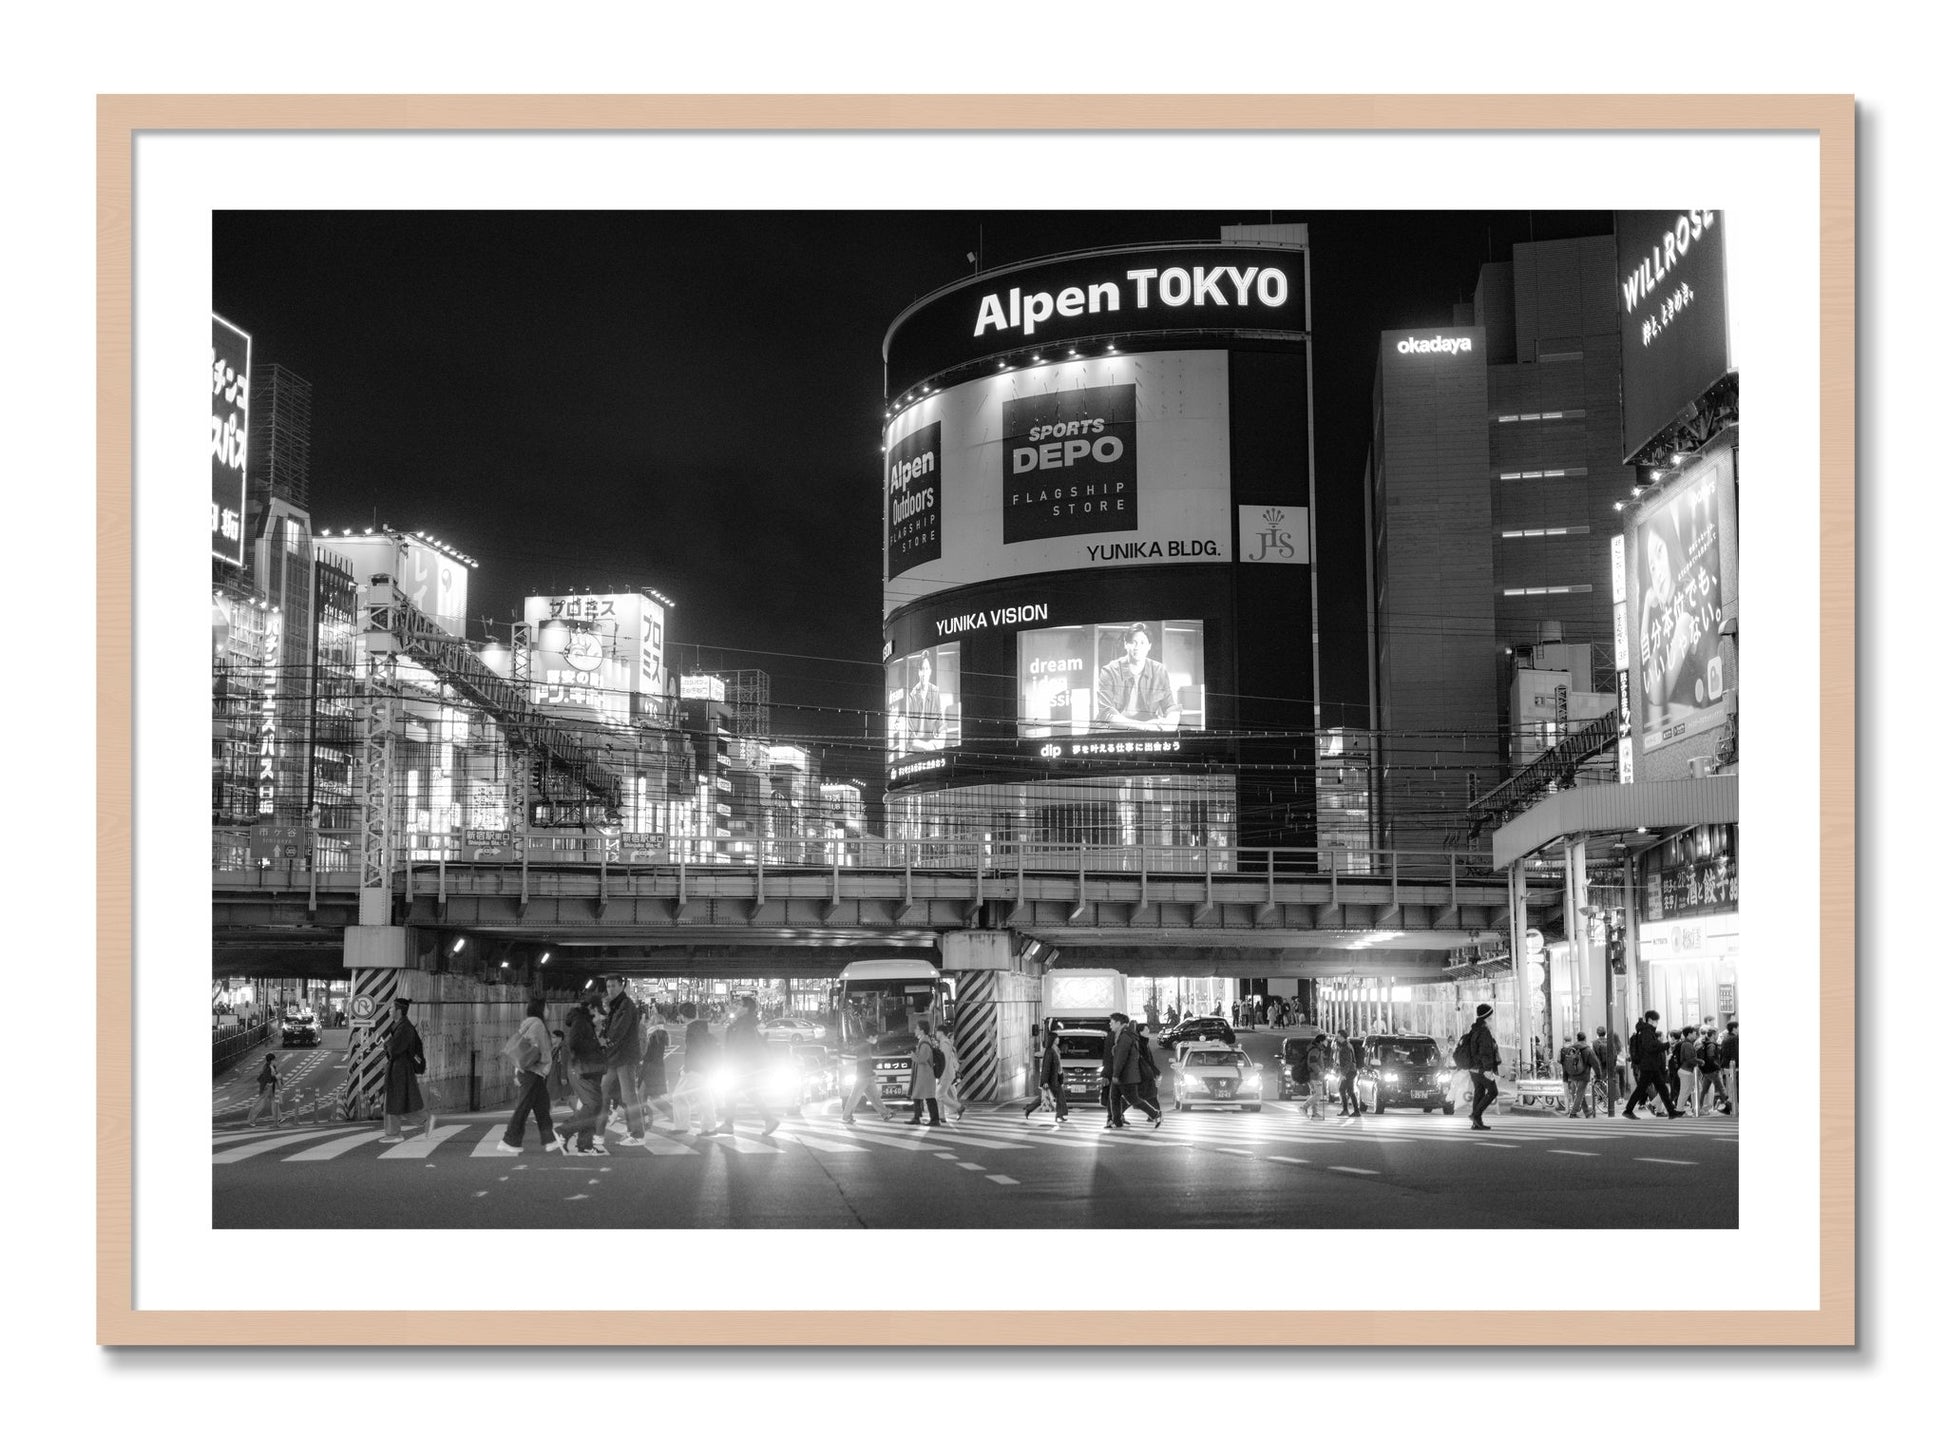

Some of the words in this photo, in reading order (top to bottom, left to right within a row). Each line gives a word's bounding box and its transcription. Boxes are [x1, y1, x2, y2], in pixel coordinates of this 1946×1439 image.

[973, 281, 1120, 337] Alpen
[1127, 266, 1288, 309] TOKYO
[1397, 336, 1473, 354] okadaya
[1029, 418, 1105, 441] SPORTS
[1013, 435, 1124, 474] DEPO
[890, 451, 934, 495] Alpen
[1013, 482, 1124, 505] FLAGSHIP
[893, 487, 934, 525] Outdoors
[1053, 499, 1125, 516] STORE
[889, 514, 935, 546] FLAGSHIP
[902, 530, 935, 553] STORE
[1087, 541, 1163, 561] YUNIKA
[1168, 540, 1221, 557] BLDG.
[549, 598, 616, 618] プロミス
[936, 612, 987, 636] YUNIKA
[989, 603, 1048, 627] VISION
[1641, 566, 1717, 666] 自分本位でも、
[1029, 657, 1083, 674] dream
[1040, 744, 1062, 758] dip
